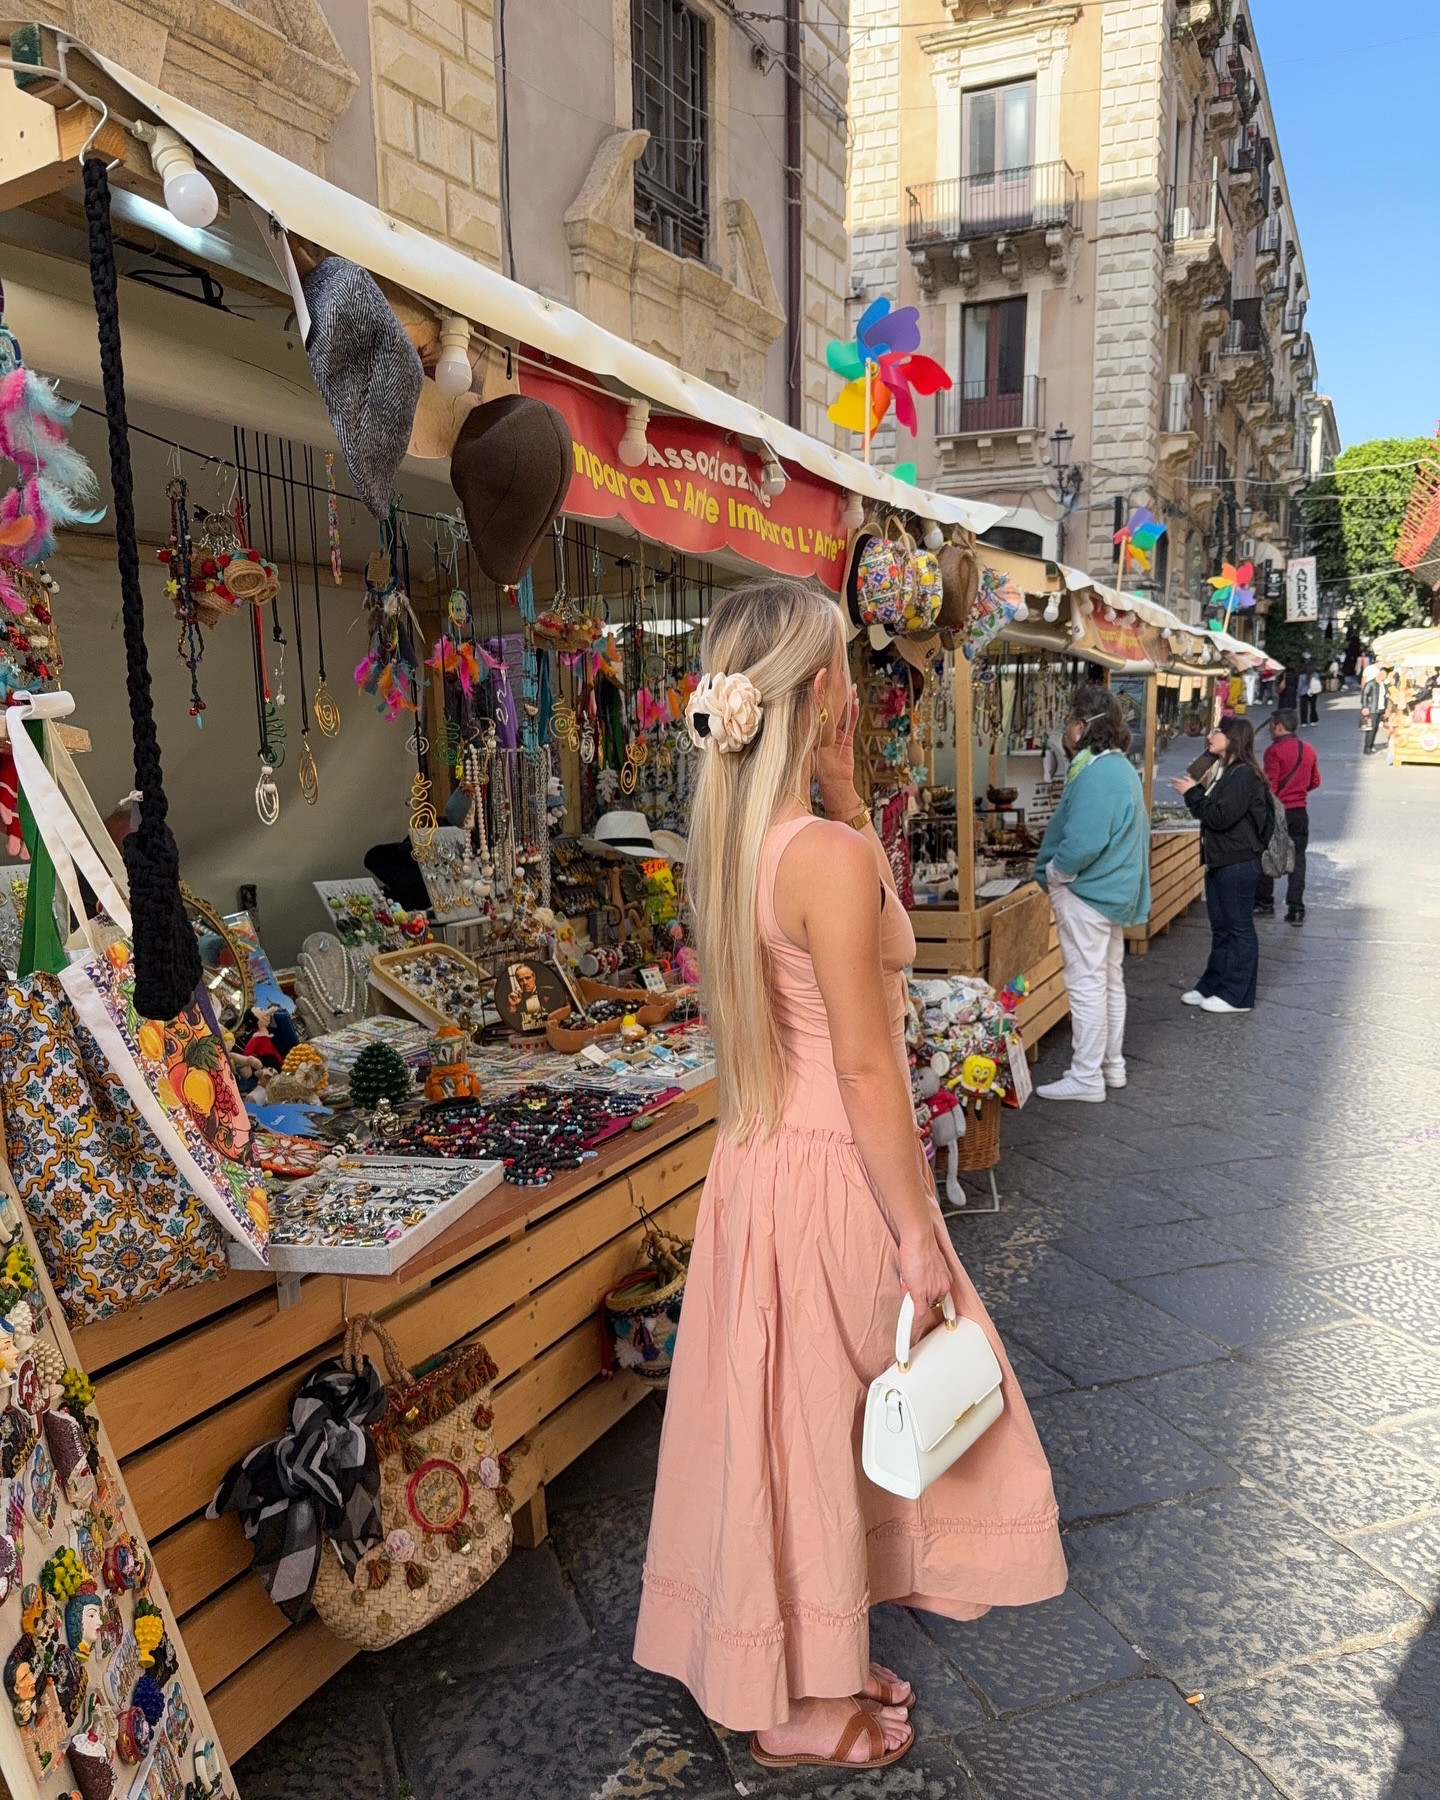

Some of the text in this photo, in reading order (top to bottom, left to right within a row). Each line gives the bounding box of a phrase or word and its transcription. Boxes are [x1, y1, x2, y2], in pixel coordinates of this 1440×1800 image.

[572, 440, 656, 505] mpara
[657, 477, 720, 525] L'Arte
[728, 497, 795, 551] Impara
[647, 443, 771, 509] Associazine
[1296, 568, 1308, 618] ANDREA
